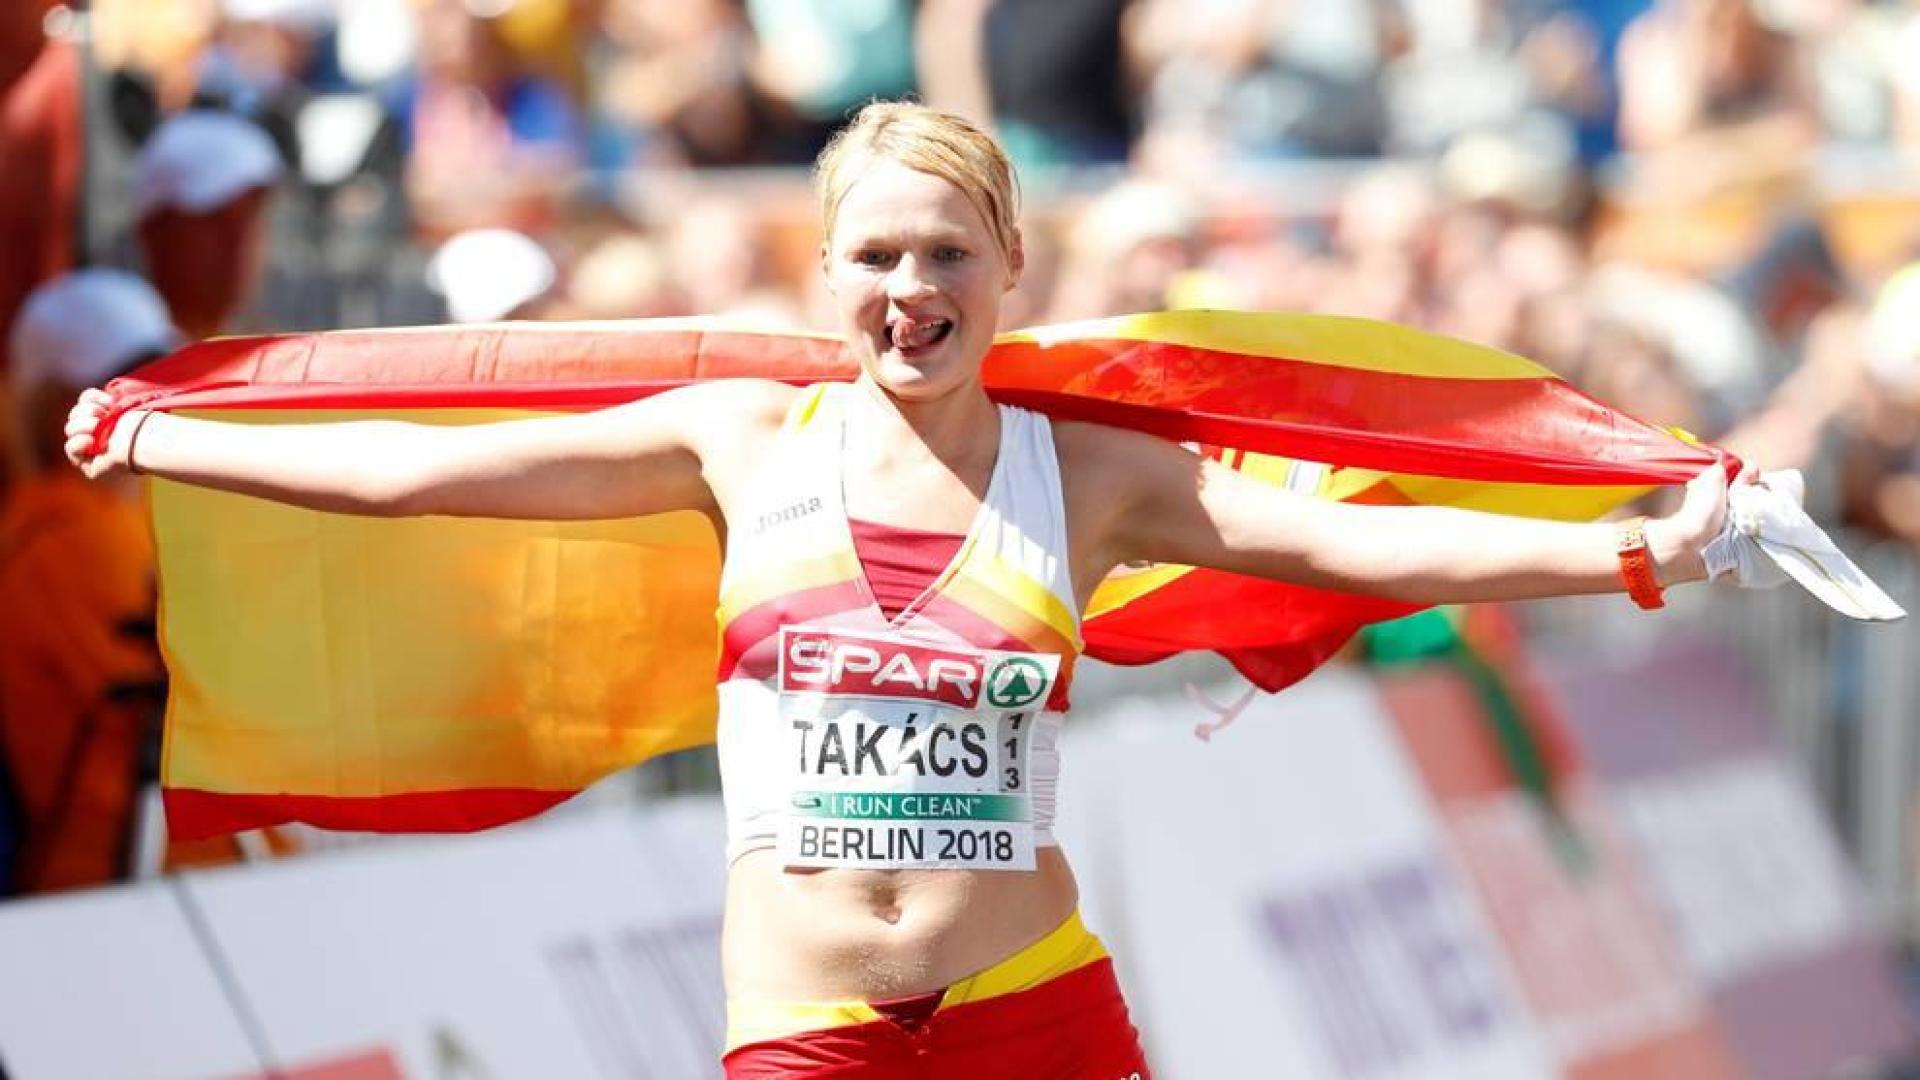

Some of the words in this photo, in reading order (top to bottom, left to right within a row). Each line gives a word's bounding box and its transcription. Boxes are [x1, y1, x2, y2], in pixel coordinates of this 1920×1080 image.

[790, 636, 977, 700] SPAR
[793, 712, 988, 778] TAKÁCS
[843, 797, 892, 816] RUN
[799, 825, 924, 860] BERLIN
[937, 829, 1013, 862] 2018
